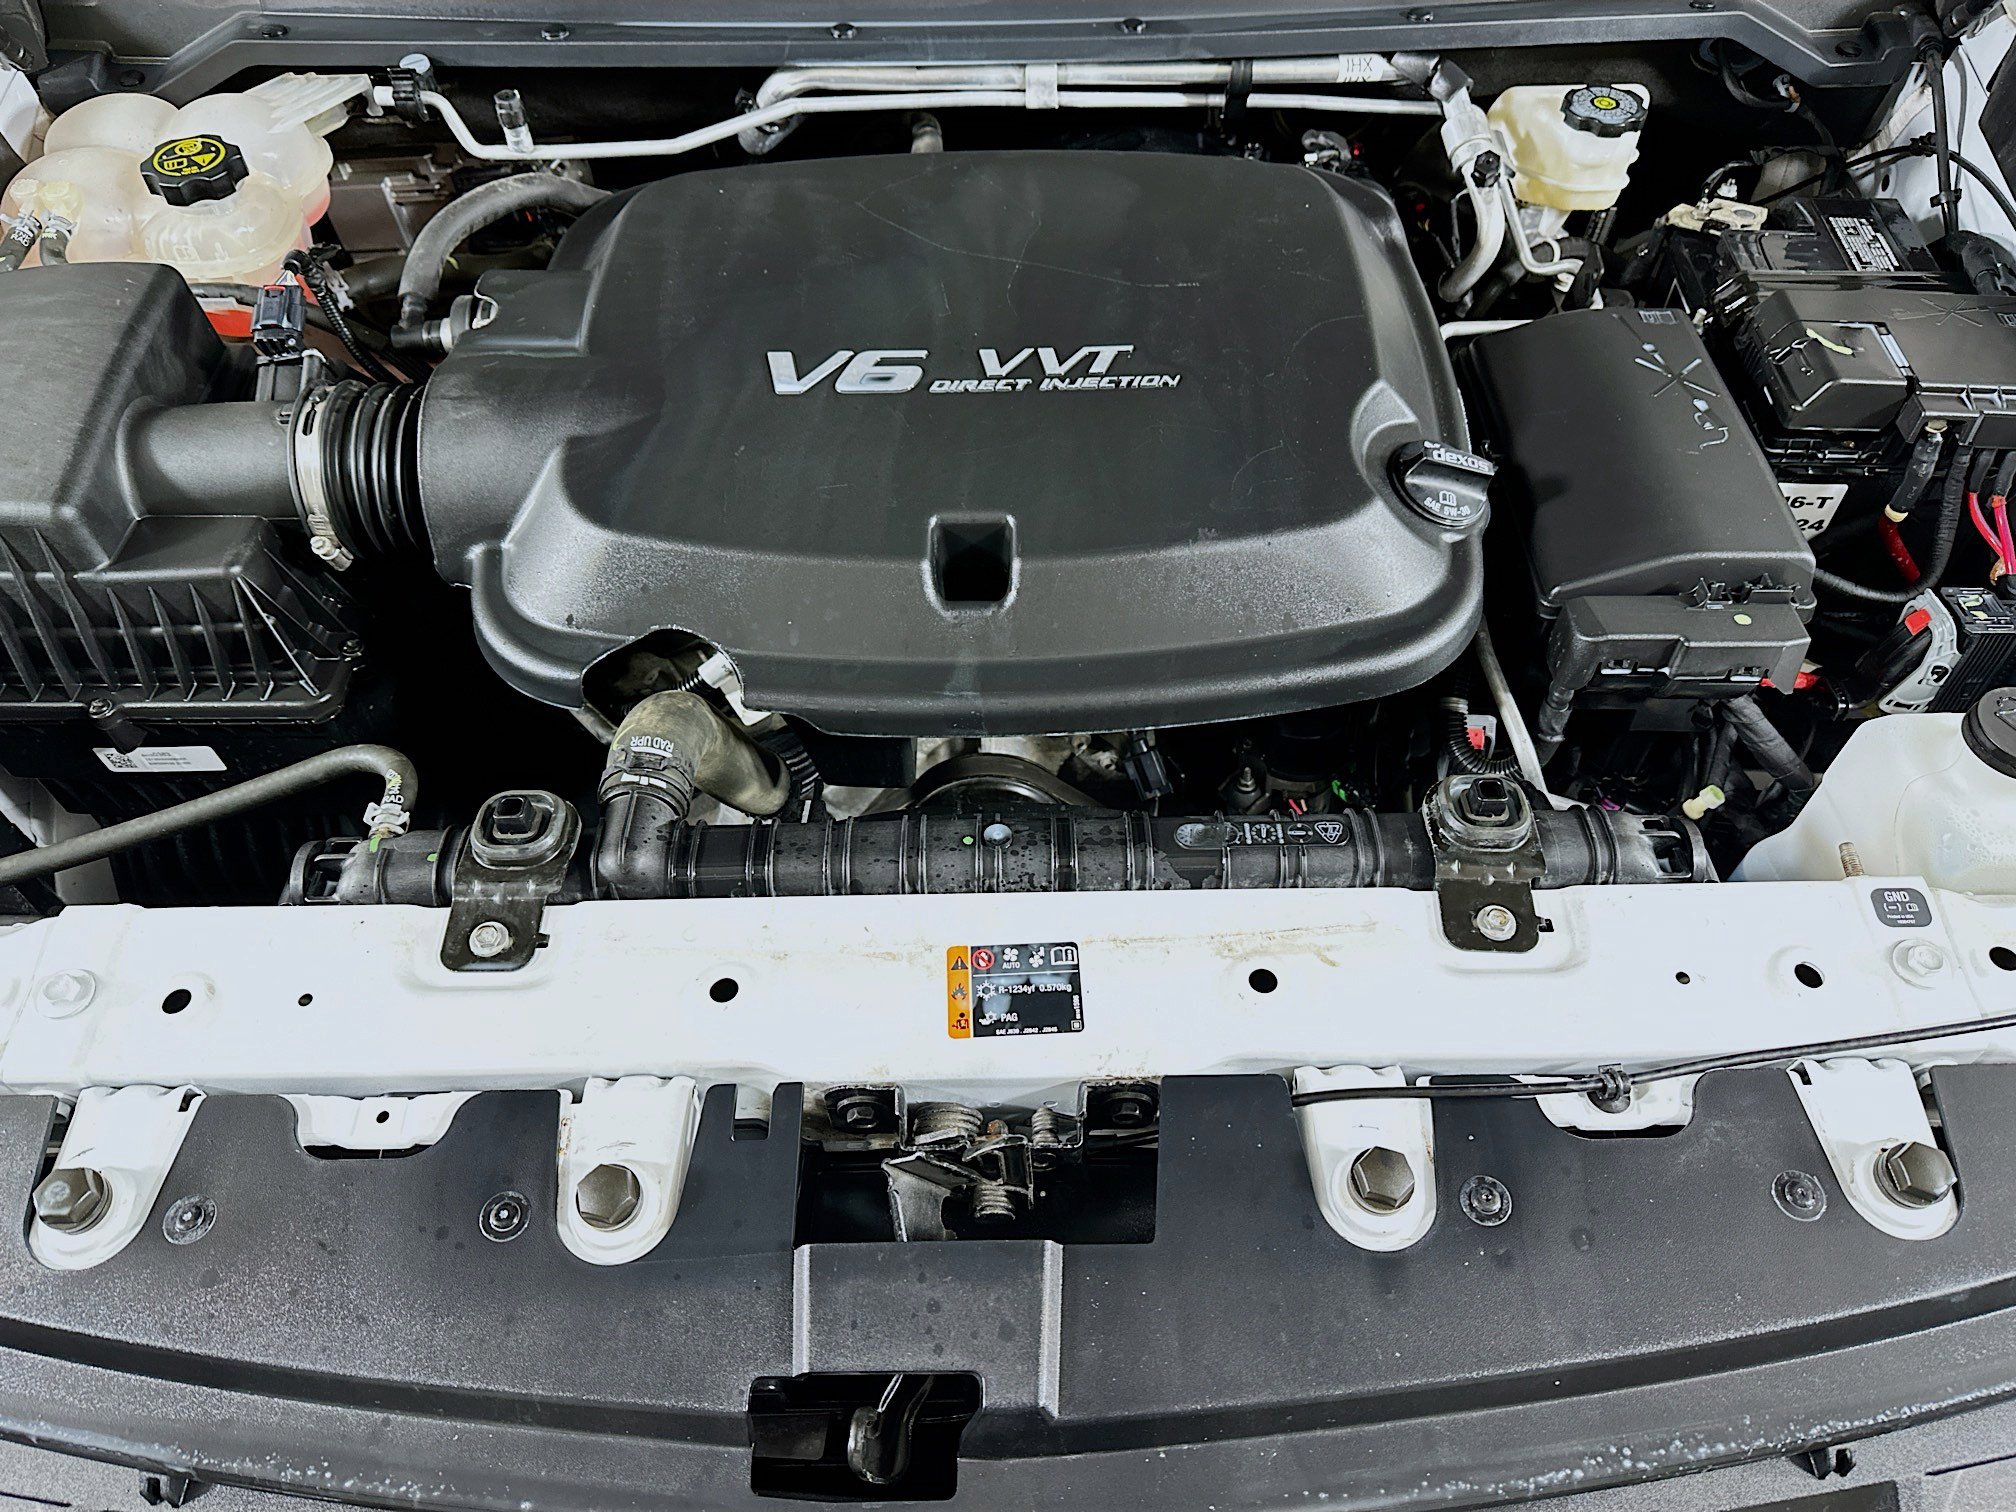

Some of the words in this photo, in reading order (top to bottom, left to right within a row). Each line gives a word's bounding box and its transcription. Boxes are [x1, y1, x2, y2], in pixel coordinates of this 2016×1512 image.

[978, 344, 1135, 377] VVT
[766, 350, 929, 395] V6
[928, 378, 1032, 394] DIRECT
[1039, 374, 1181, 392] INJECTION
[1432, 447, 1489, 472] dexos
[1424, 497, 1441, 512] SAE
[1443, 505, 1471, 516] 5W-30
[630, 736, 652, 747] UPR
[652, 737, 674, 753] RAD
[1883, 891, 1910, 902] GND
[998, 984, 1035, 995] R-1234yf
[1039, 983, 1073, 993] 0.570kg
[1000, 1012, 1018, 1022] PAG
